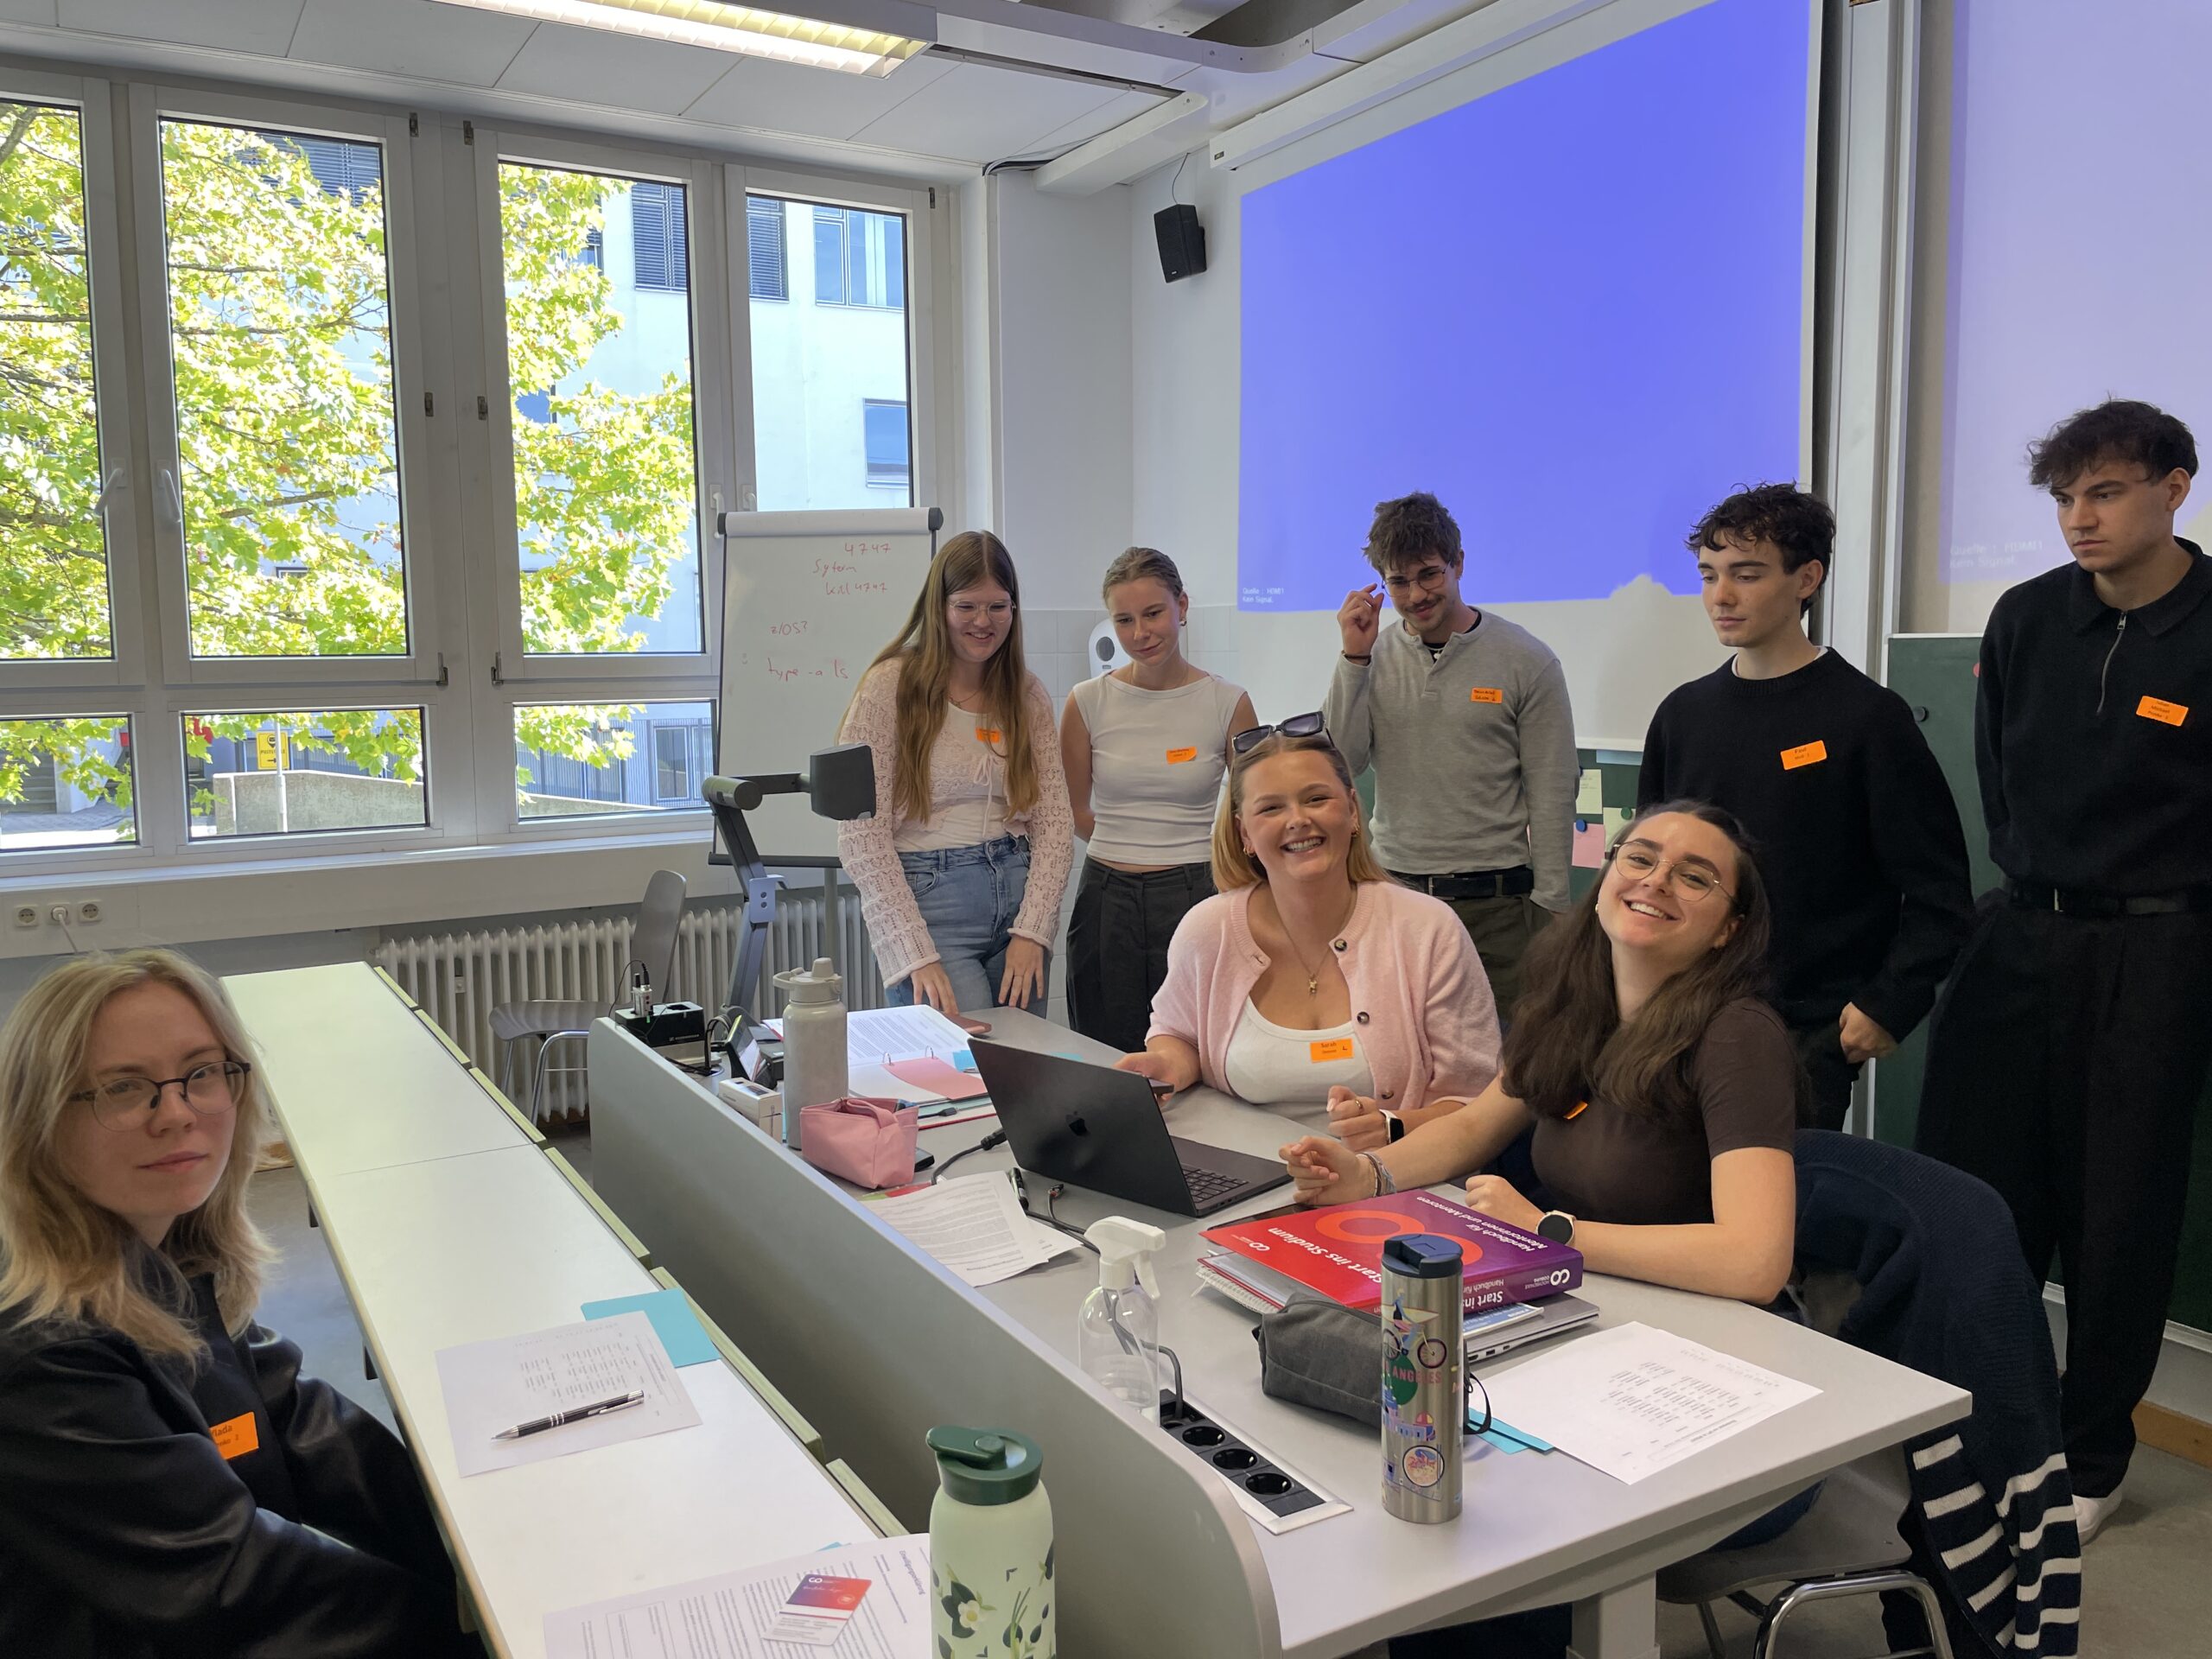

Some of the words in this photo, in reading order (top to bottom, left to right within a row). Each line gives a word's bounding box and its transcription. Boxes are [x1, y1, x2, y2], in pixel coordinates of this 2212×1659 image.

[844, 543, 892, 556] 4747
[826, 582, 850, 594] kill
[855, 582, 887, 594] 4747
[768, 657, 798, 682] type
[1417, 1196, 1463, 1216] Mentoren
[1458, 1213, 1483, 1224] und
[1268, 1227, 1329, 1255] Studium
[1481, 1222, 1548, 1249] Mentorinnen
[1482, 1230, 1535, 1252] Handbuch
[1325, 1252, 1353, 1265] ins
[1473, 1279, 1504, 1292] Handbuch
[1478, 1291, 1503, 1304] Start
